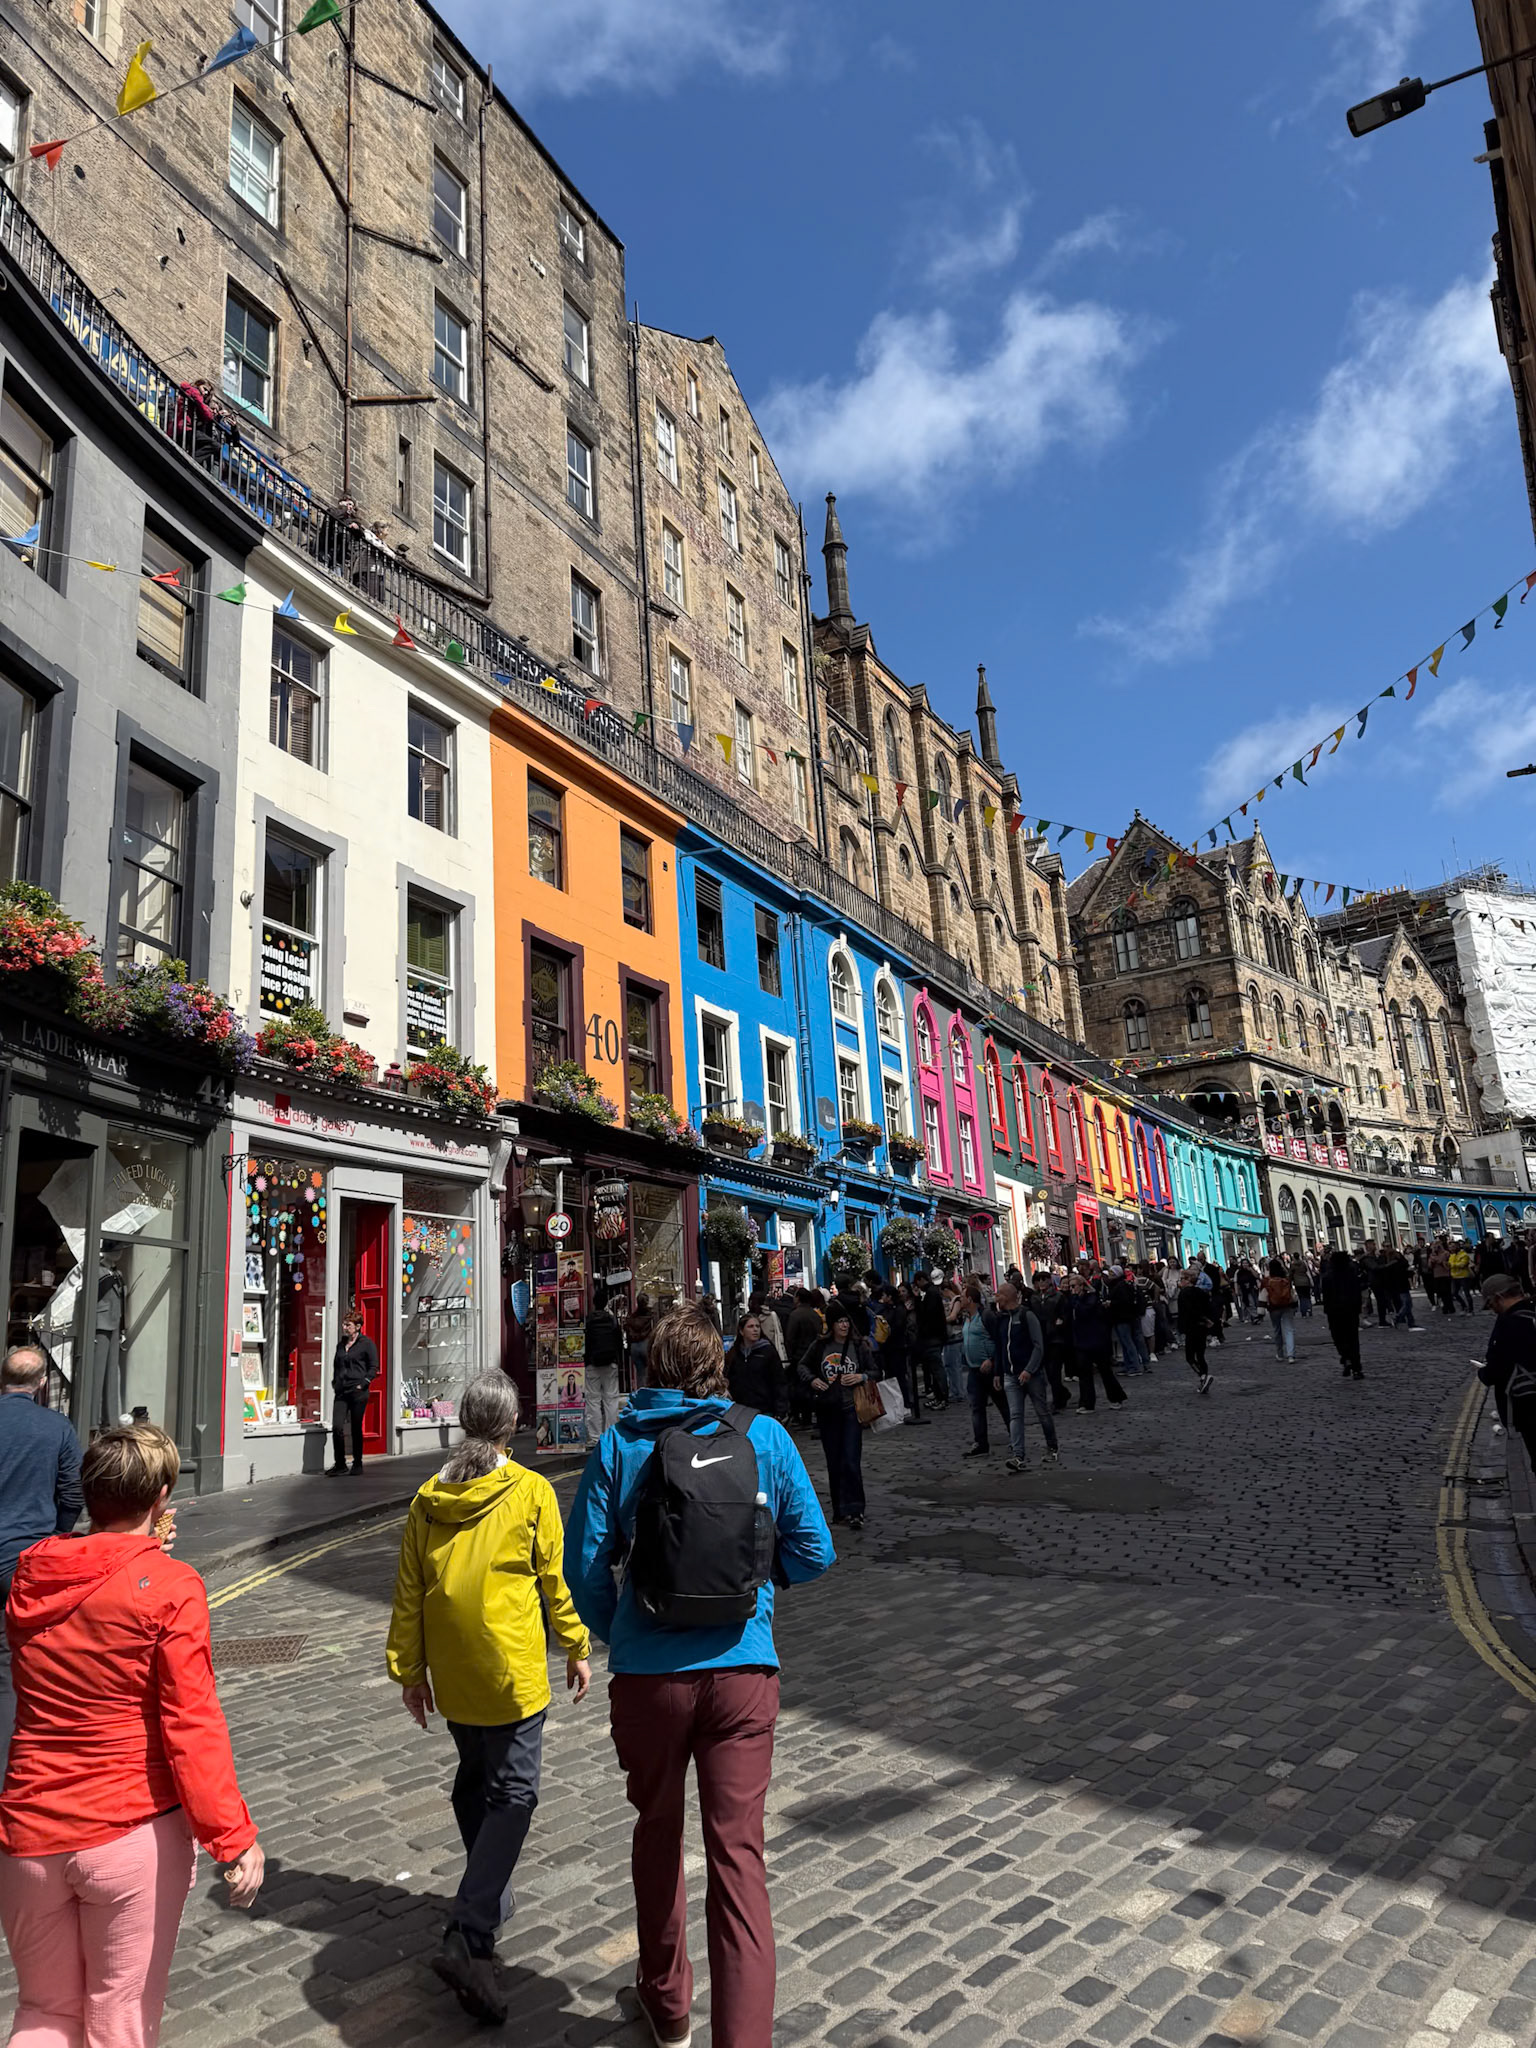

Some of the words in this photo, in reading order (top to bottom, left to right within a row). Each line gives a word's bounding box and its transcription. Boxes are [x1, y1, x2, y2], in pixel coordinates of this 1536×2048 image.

[285, 950, 308, 970] Local
[264, 961, 282, 977] and
[282, 965, 312, 987] Design
[282, 981, 305, 1001] 2003
[22, 1020, 128, 1078] LADIESWEAR
[585, 1013, 620, 1065] 40
[197, 1075, 226, 1107] 44
[257, 1101, 274, 1117] the
[275, 1106, 290, 1121] red
[1418, 1165, 1437, 1175] SCOTTS
[550, 1219, 569, 1232] 20
